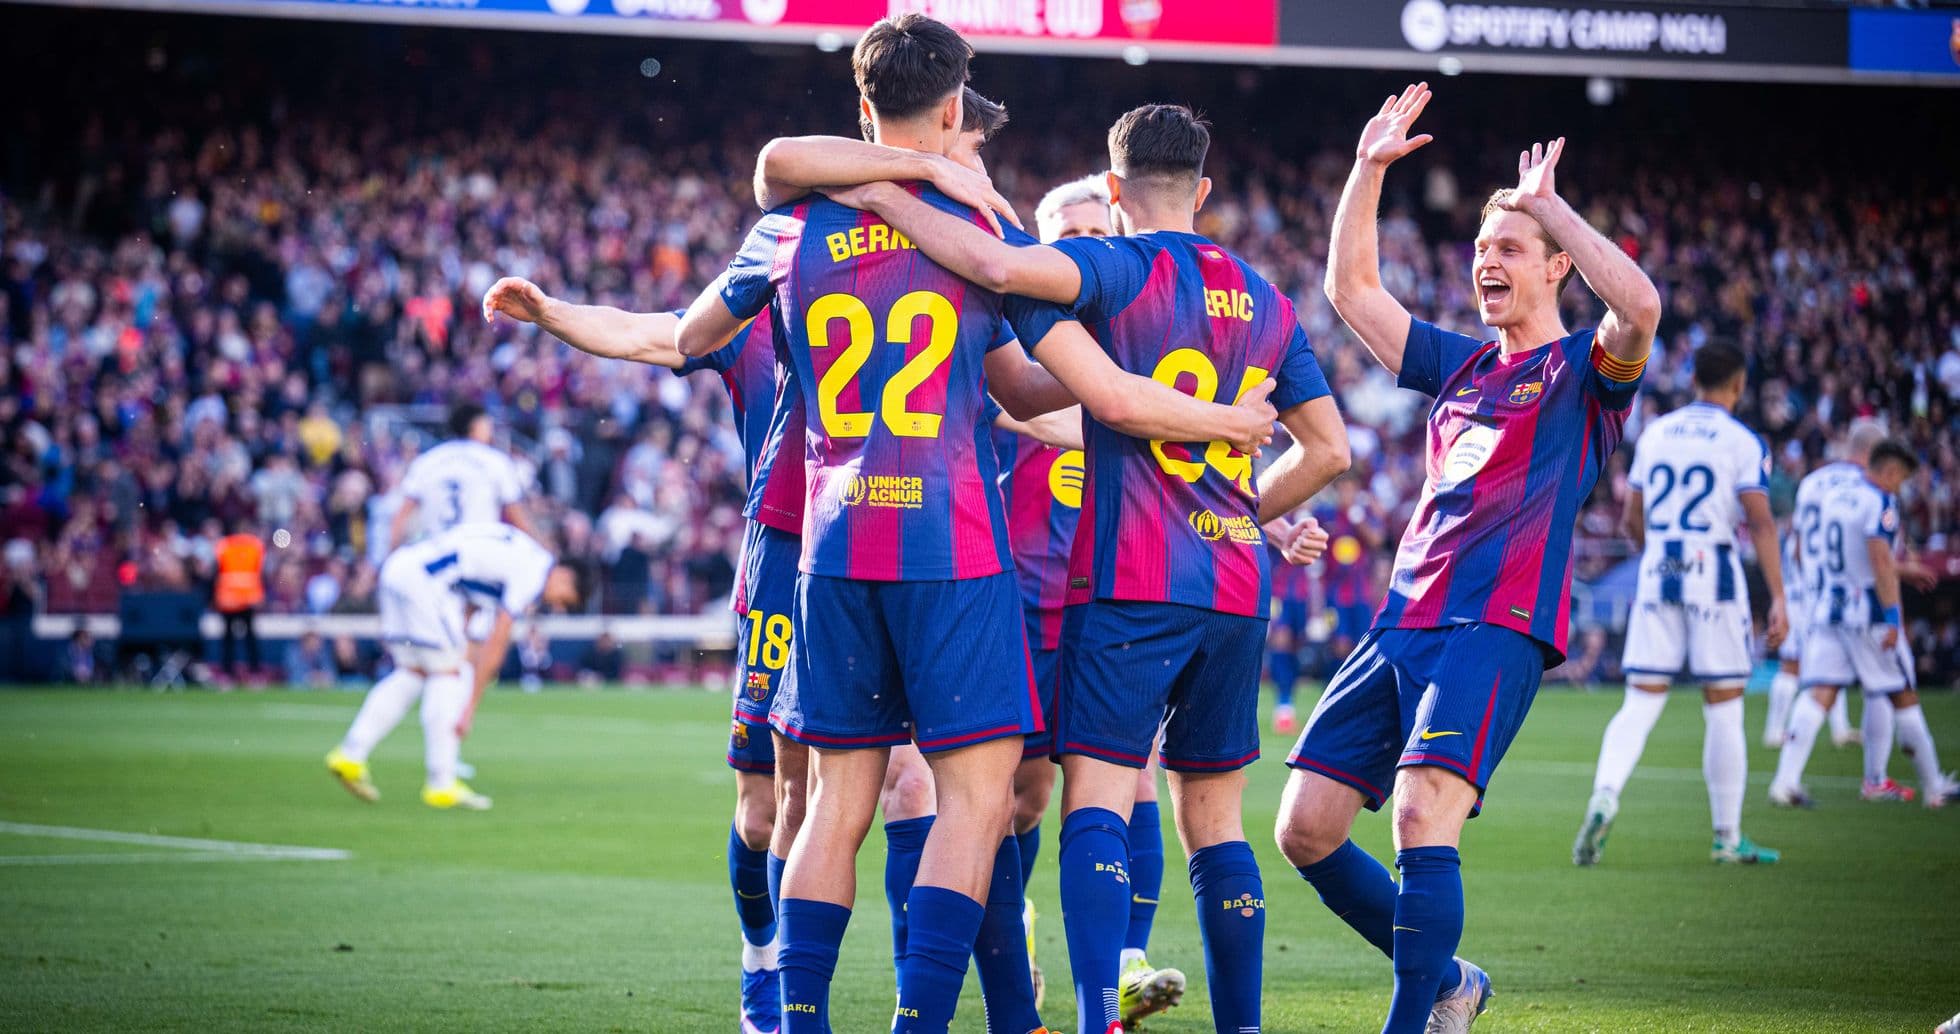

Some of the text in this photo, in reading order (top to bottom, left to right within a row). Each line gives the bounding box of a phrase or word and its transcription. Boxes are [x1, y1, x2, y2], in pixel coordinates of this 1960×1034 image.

[825, 224, 917, 262] BERN
[1203, 286, 1254, 321] ERIC
[806, 290, 958, 438] 22
[868, 476, 922, 489] UNHCR
[868, 489, 922, 502] ACNUR
[1648, 464, 1715, 532] 22
[747, 610, 792, 669] 18
